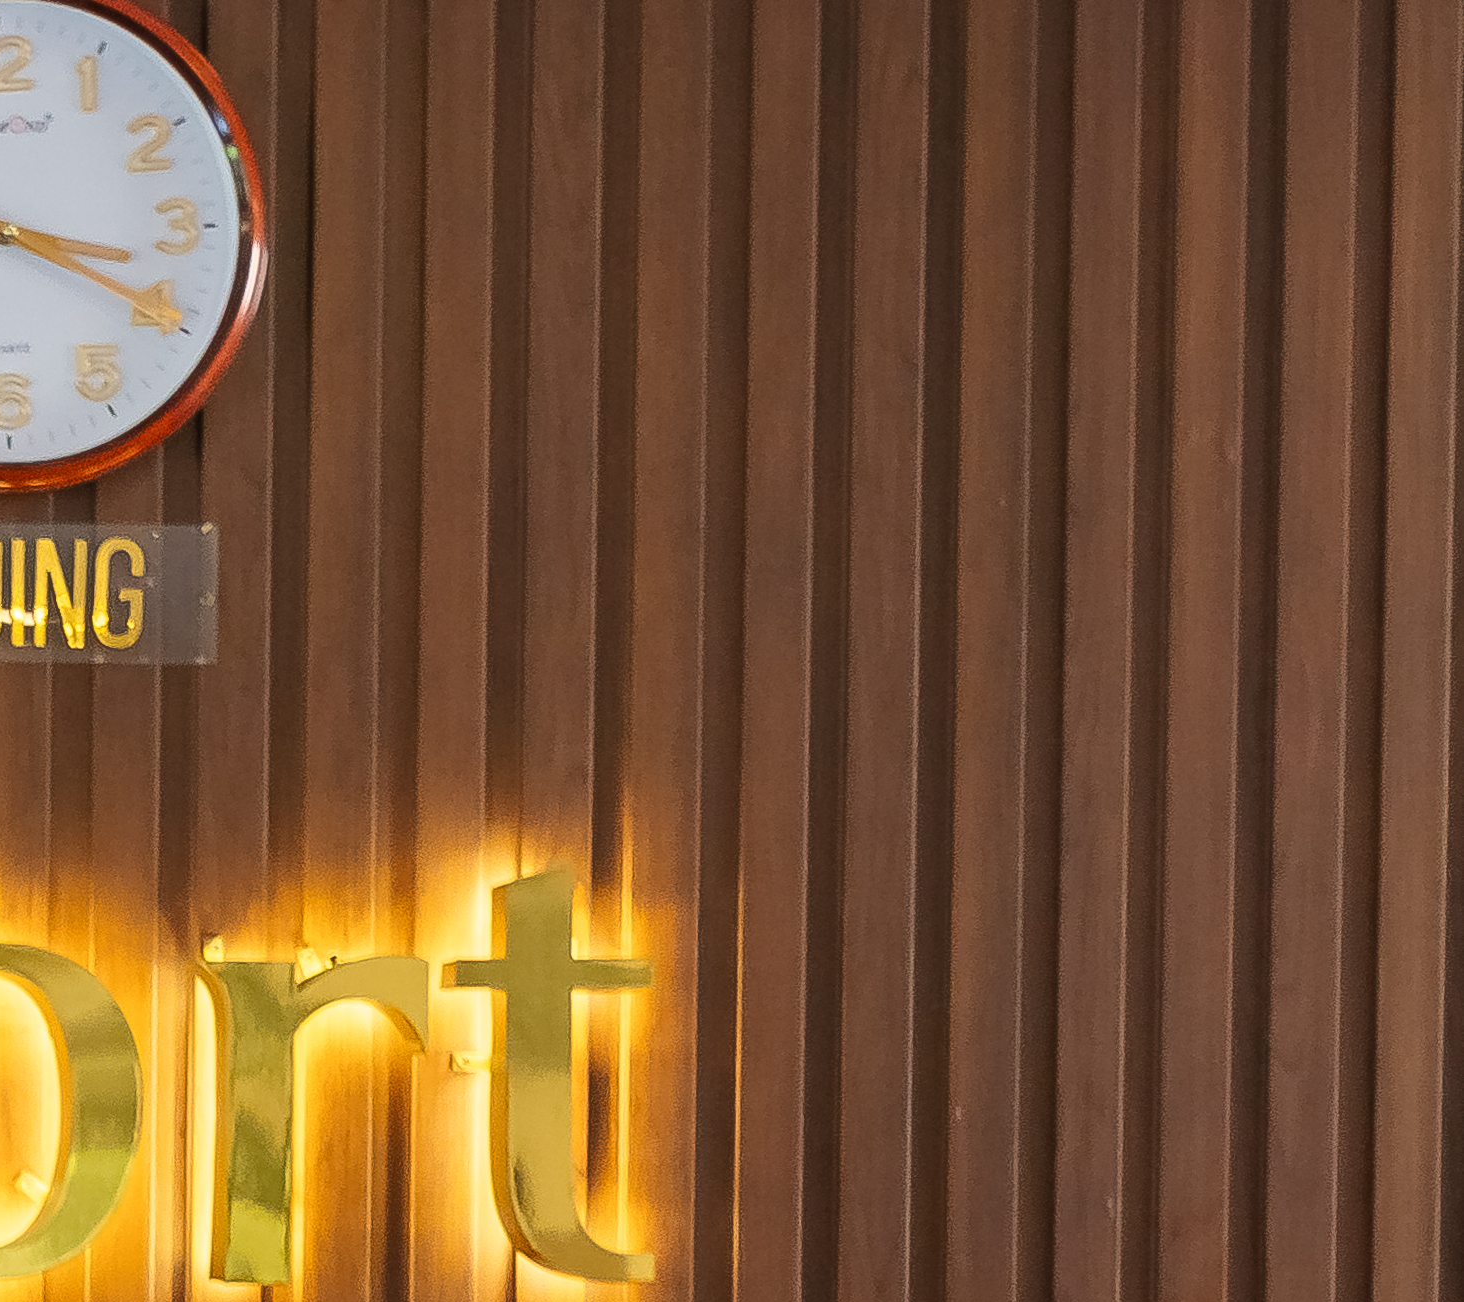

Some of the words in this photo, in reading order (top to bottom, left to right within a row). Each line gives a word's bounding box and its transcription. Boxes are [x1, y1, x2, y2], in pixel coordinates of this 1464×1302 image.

[76, 55, 98, 113] 1
[126, 114, 173, 173] 2
[154, 198, 199, 255] 3
[131, 280, 182, 335] 4
[75, 345, 120, 402] 5
